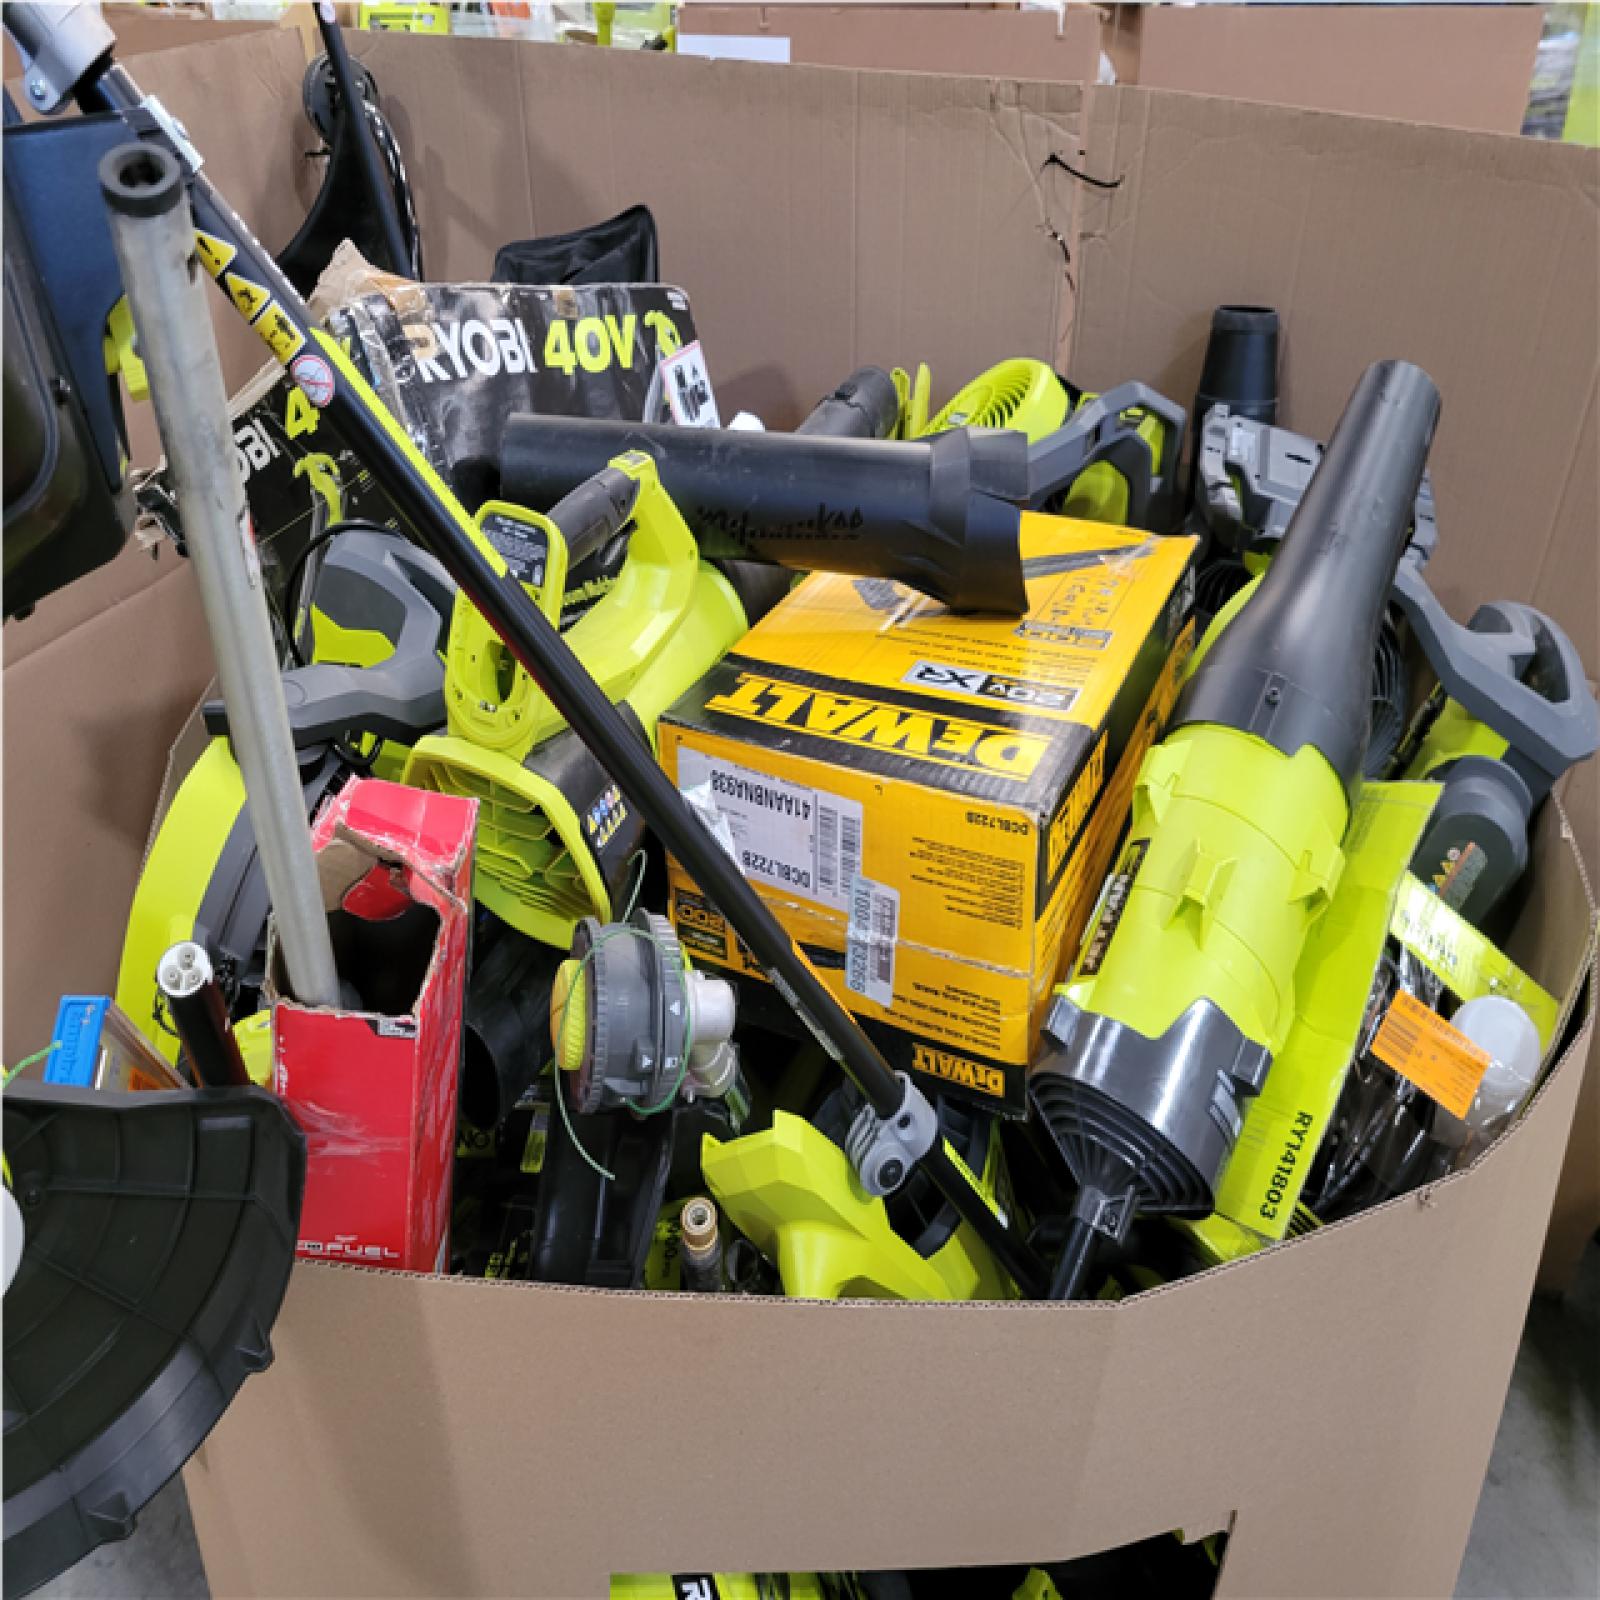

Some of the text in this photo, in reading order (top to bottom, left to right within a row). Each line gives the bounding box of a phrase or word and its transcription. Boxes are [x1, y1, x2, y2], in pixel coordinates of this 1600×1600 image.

[404, 314, 637, 382] RYOBI 40V
[704, 671, 1052, 782] DEWALT
[912, 1043, 1005, 1097] DEWALT
[1259, 1111, 1313, 1221] RY141803
